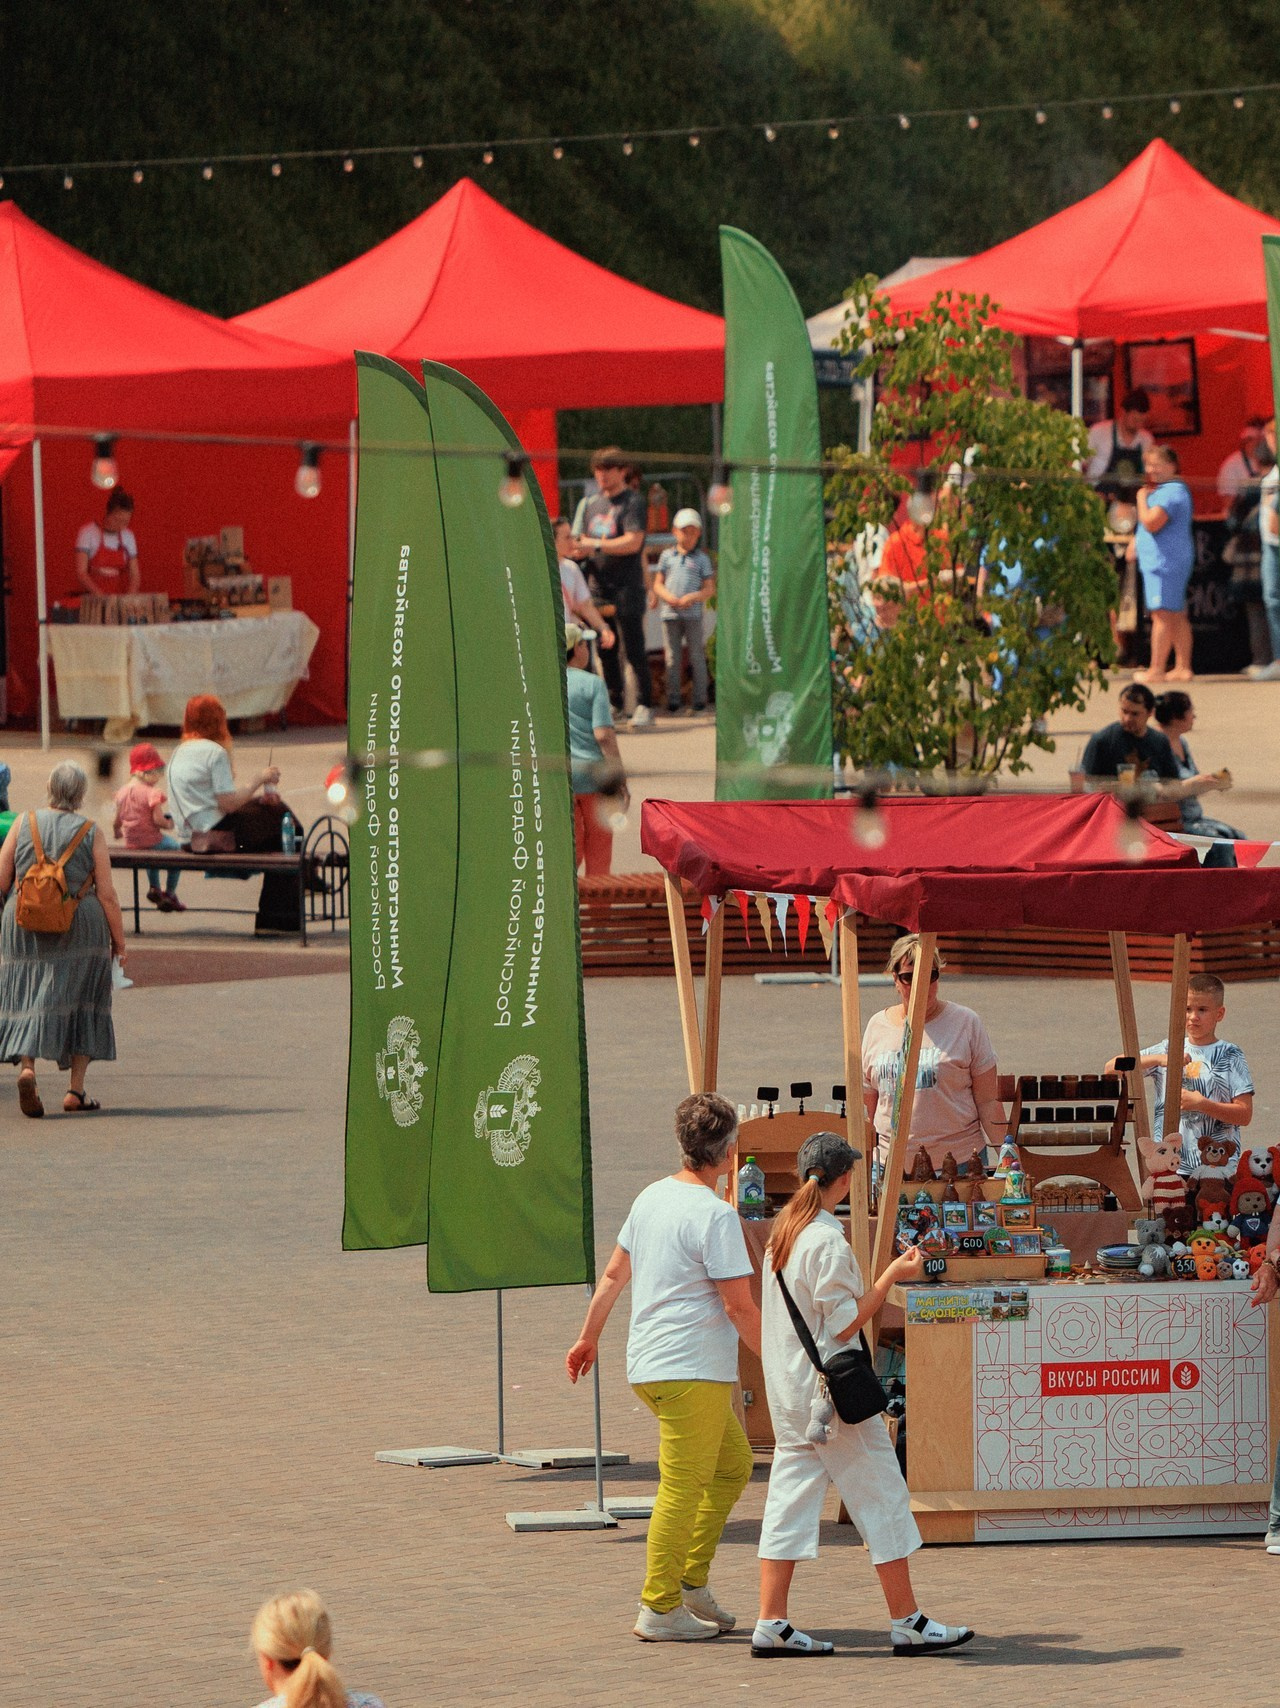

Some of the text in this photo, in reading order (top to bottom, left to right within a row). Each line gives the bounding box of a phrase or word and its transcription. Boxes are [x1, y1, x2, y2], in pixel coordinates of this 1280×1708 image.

[963, 1237, 983, 1248] 600
[926, 1259, 945, 1272] 100
[1177, 1259, 1195, 1272] 350
[916, 1295, 970, 1308] МАГНИТЫ
[919, 1306, 979, 1319] СМОЛЕНСК
[1048, 1367, 1160, 1389] ВКУСЫ РОССИИ
